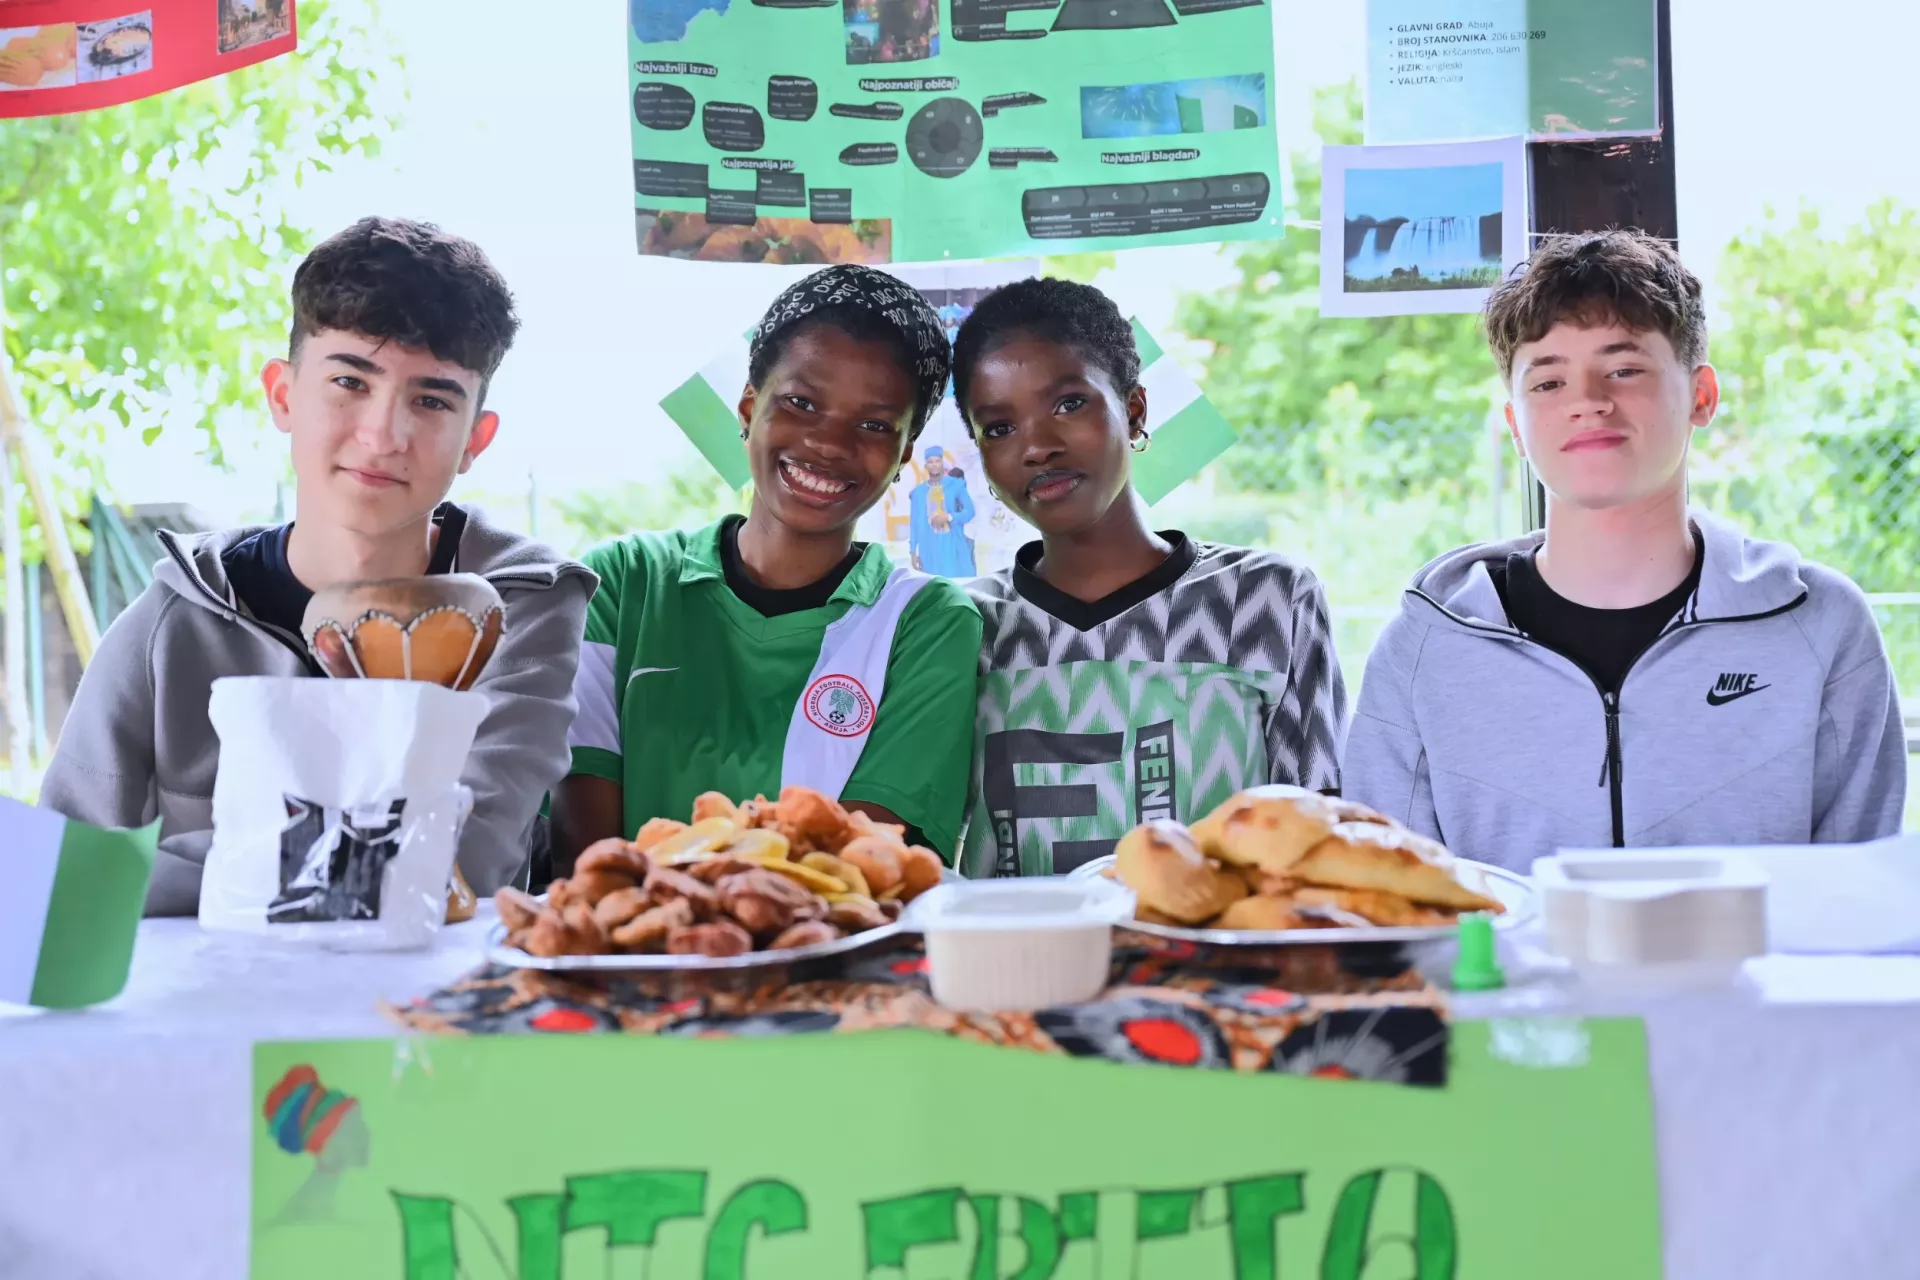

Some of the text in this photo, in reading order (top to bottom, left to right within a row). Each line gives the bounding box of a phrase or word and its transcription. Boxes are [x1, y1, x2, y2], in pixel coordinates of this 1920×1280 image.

[1397, 23, 1433, 33] GLAVNI
[1468, 21, 1494, 30] Abuja
[1397, 37, 1421, 46] BROJ
[1491, 32, 1508, 41] 206
[1510, 31, 1527, 40] 630
[1529, 30, 1546, 39] 269
[689, 64, 717, 75] izrazi
[861, 80, 923, 91] Najpoznatiji
[1101, 150, 1198, 164] Najvažniji blagdani
[1715, 673, 1758, 692] NIKE
[810, 681, 870, 730] NIGERIA FOOTBALL FEDERATION
[824, 722, 849, 733] ABUJA
